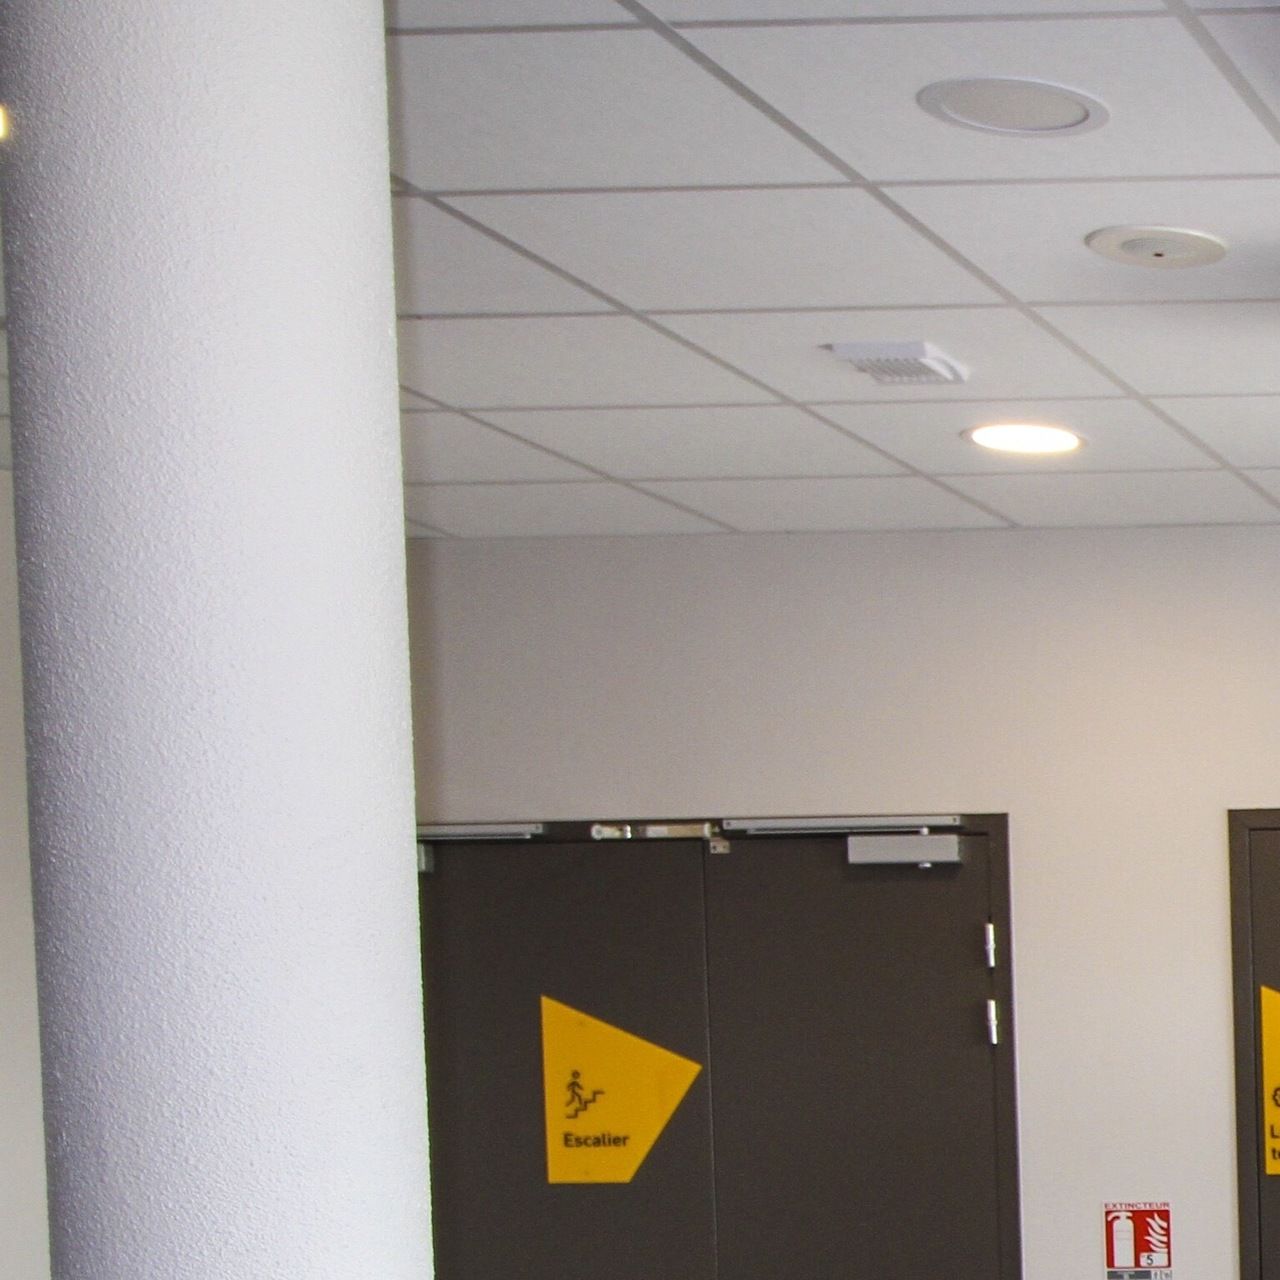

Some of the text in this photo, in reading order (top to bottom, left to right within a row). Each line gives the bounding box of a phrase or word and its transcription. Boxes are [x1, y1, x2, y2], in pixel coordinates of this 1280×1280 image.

[563, 1131, 630, 1148] Escalier
[1104, 1202, 1171, 1210] EXTINCTEUR
[1145, 1254, 1154, 1267] 5
